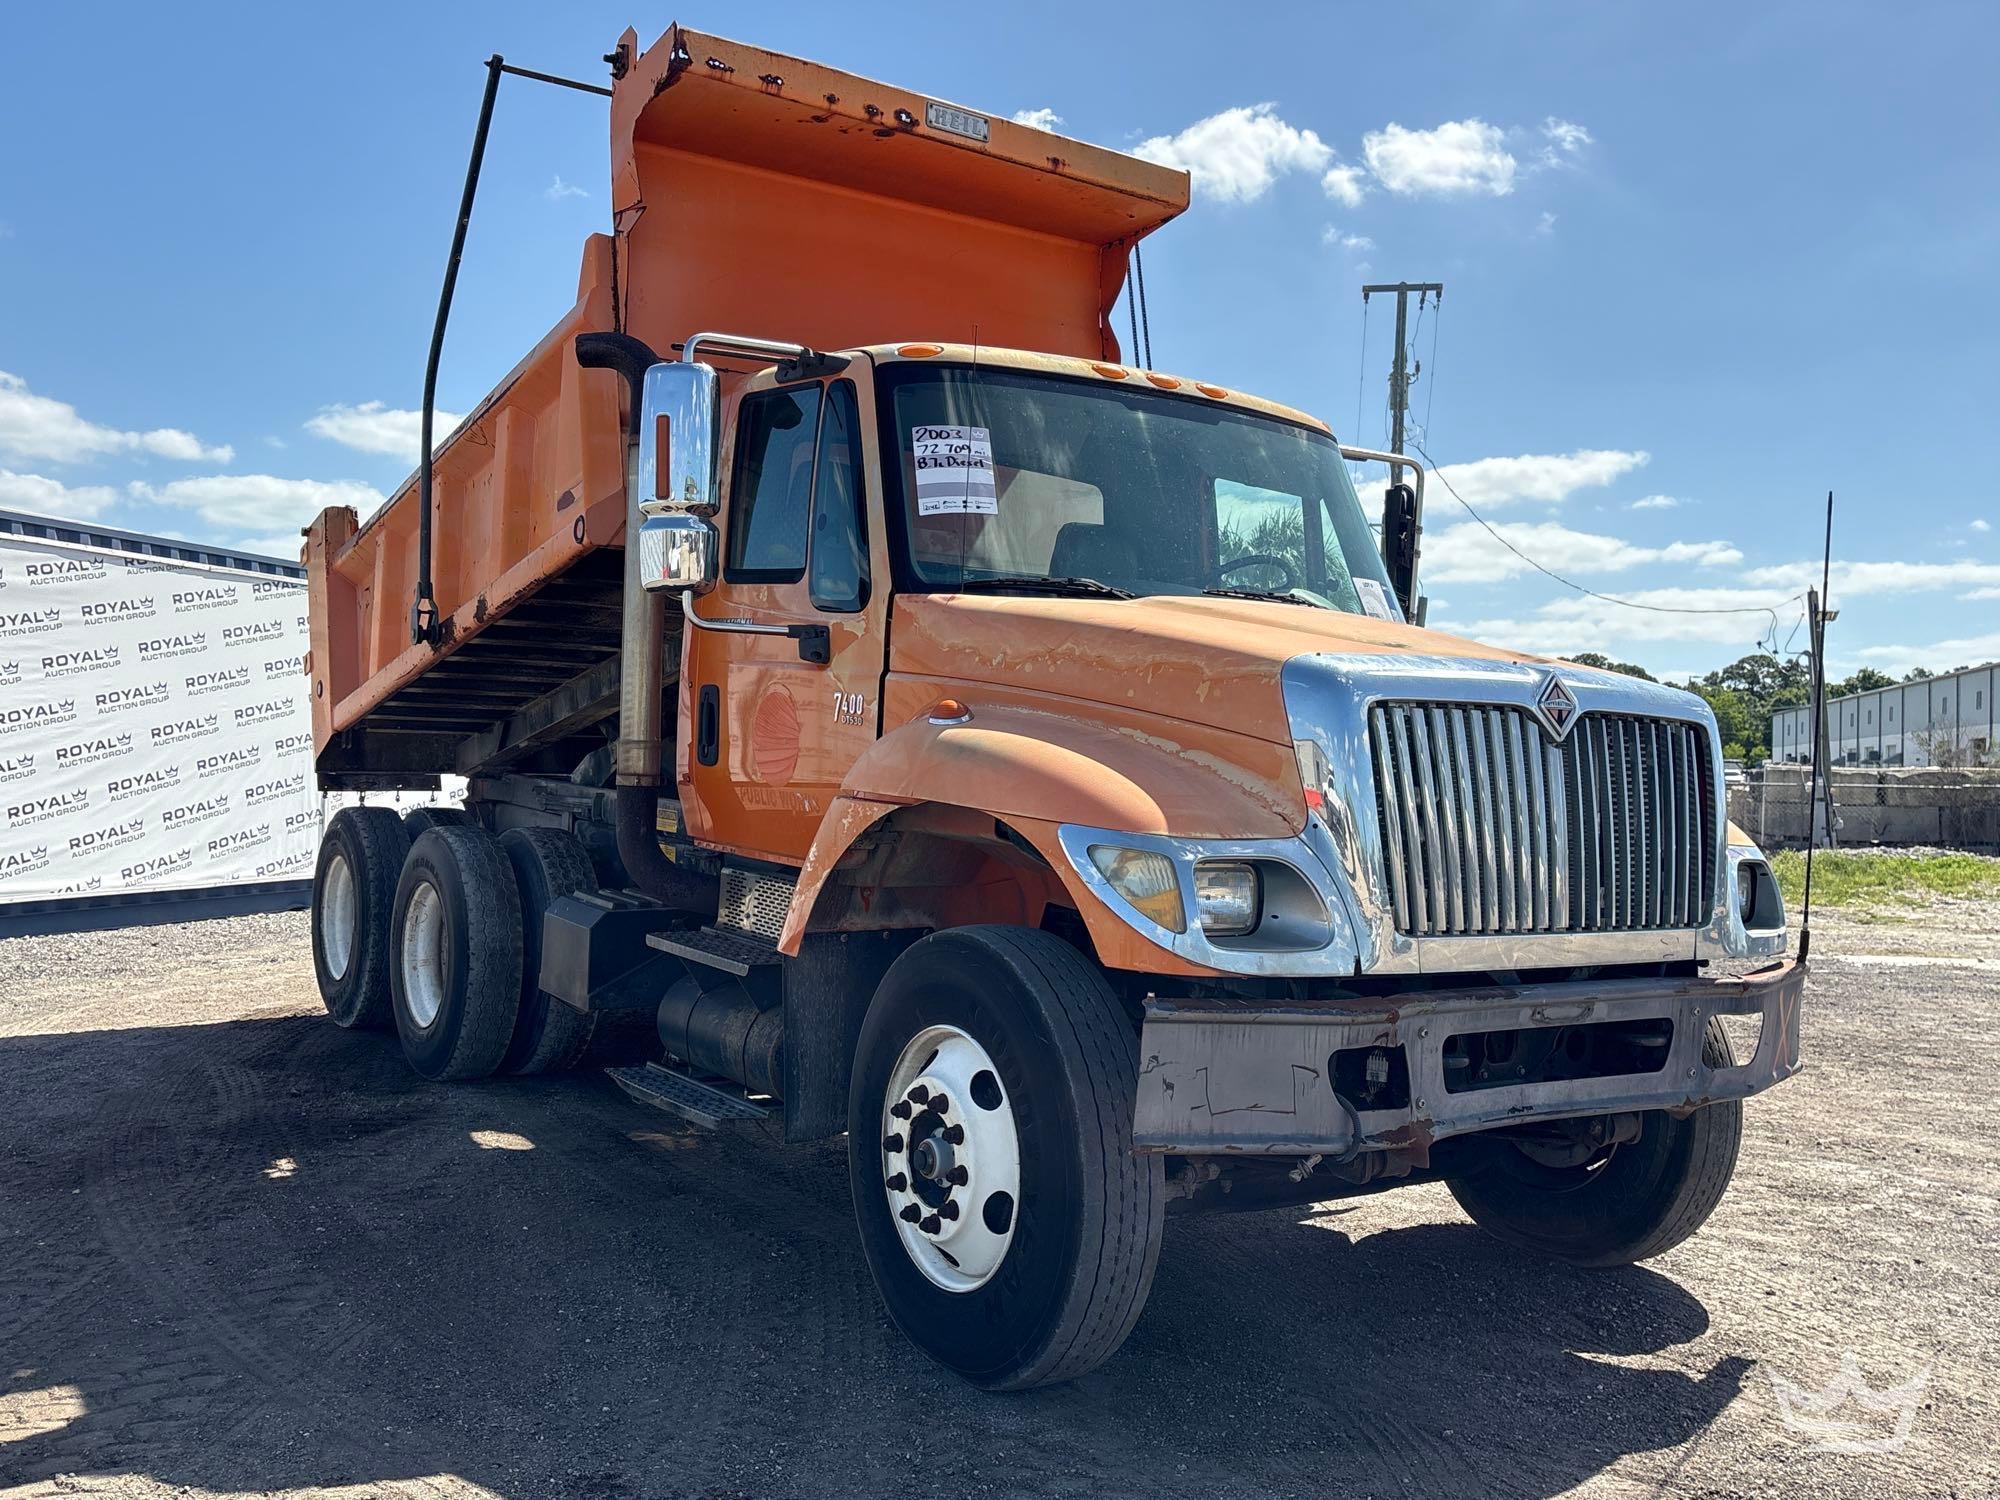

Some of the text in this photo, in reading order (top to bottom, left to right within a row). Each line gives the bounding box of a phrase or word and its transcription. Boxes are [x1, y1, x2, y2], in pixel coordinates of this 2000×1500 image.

[935, 107, 982, 136] HEIL
[915, 427, 963, 442] 2003
[917, 444, 940, 454] 72
[945, 456, 985, 468] Diesel
[26, 561, 89, 576] ROYAL
[127, 566, 165, 575] AUCTION
[30, 571, 107, 586] AUCTION GROUP
[172, 588, 224, 604] ROYAL
[175, 598, 239, 613] AUCTION GROUP
[254, 593, 286, 601] AUCTION
[81, 600, 140, 616] ROYAL
[0, 611, 44, 628] OYAL
[28, 622, 63, 633] GROUP
[84, 610, 156, 626] AUCTION GROUP
[222, 622, 270, 639] ROYAL
[225, 632, 284, 647] AUCTION GROUP
[138, 635, 193, 653] ROYAL
[140, 645, 208, 662] AUCTION GROUP
[42, 649, 104, 669] ROYAL
[44, 659, 121, 678] AUCTION GROUP
[264, 657, 302, 672] ROYA
[0, 676, 22, 686] OUP
[185, 670, 236, 688] ROYAL
[267, 670, 298, 680] AUCTION
[96, 686, 153, 706] ROYAL
[188, 679, 251, 696] AUCTION GROUP
[98, 695, 170, 715] AUCTION GROUP
[234, 701, 282, 720] ROYAL
[0, 713, 77, 734] UCTION GROUP
[236, 709, 295, 728] AUCTION GROUP
[151, 718, 204, 739] ROYAL
[153, 727, 219, 747] AUCTION GROUP
[56, 738, 117, 760] ROYAL
[275, 733, 312, 750] ROYA
[58, 747, 134, 769] AUCTION GROUP
[197, 750, 247, 771] ROYAL
[277, 745, 309, 758] AUCTION
[0, 769, 36, 783] GROUP
[199, 758, 261, 779] AUCTION GROUP
[108, 771, 165, 793] ROYAL
[110, 779, 181, 802] AUCTION GROUP
[245, 778, 292, 799] ROYAL
[247, 786, 306, 807] AUCTION GROUP
[7, 794, 72, 819] ROYAL
[10, 802, 90, 829] AUCTION GROUP
[162, 800, 215, 823] ROYAL
[164, 807, 231, 831] AUCTION GROUP
[285, 808, 323, 827] ROYA
[69, 825, 129, 850] ROYAL
[287, 821, 317, 835] AUCTION
[71, 832, 146, 859] AUCTION GROUP
[208, 829, 258, 852] ROYAL
[210, 835, 272, 860] AUCTION GROUP
[14, 860, 50, 876] GROUP
[121, 854, 178, 880] ROYAL
[124, 861, 193, 888] AUCTION GROUP
[256, 855, 302, 877] ROYAL
